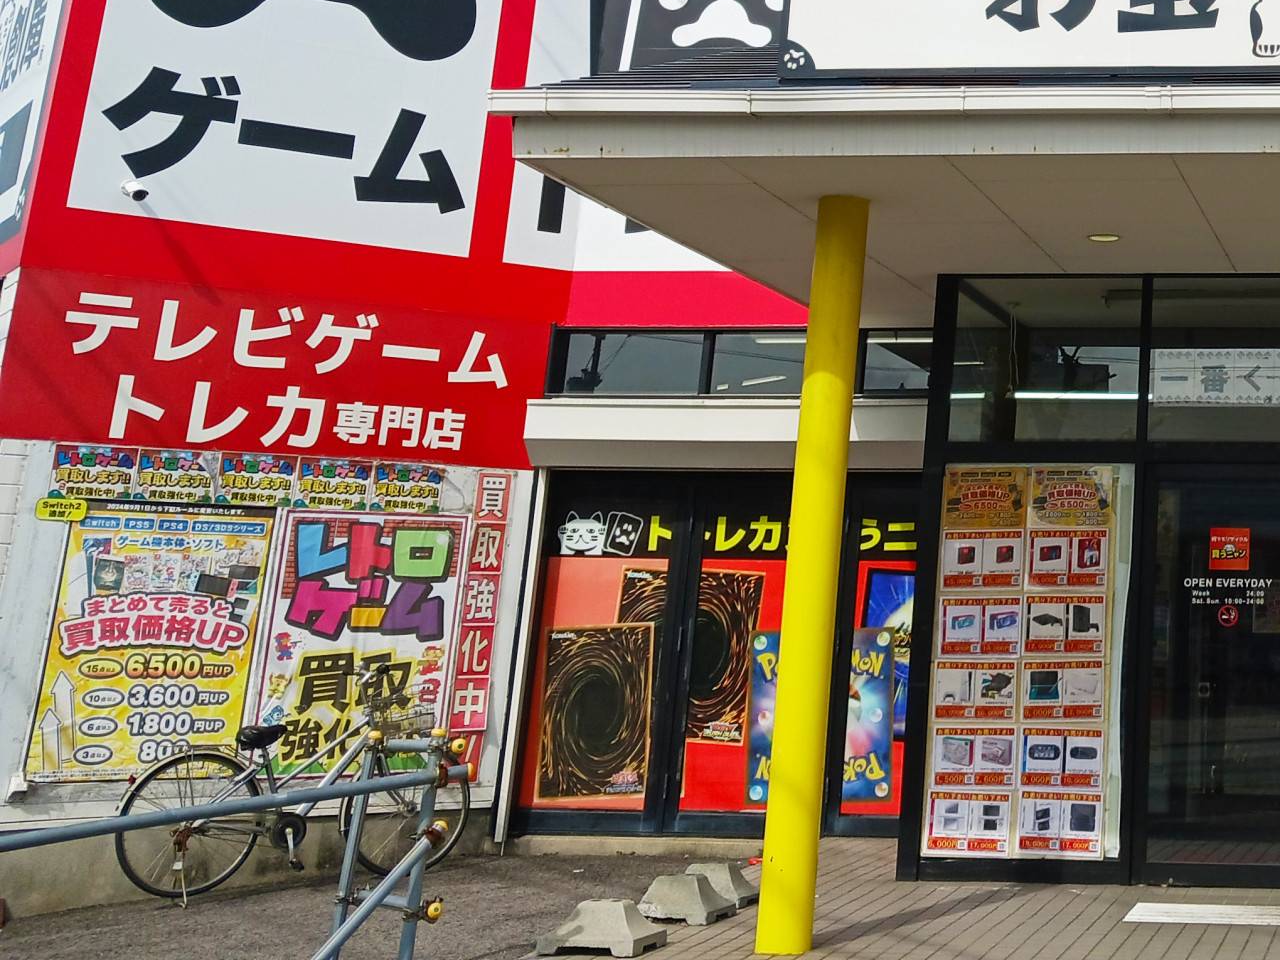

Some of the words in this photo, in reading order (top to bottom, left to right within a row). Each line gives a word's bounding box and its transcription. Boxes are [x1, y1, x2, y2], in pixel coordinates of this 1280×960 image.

[102, 66, 466, 215] ゲーム
[64, 290, 509, 390] テレビゲーム
[108, 374, 466, 451] トレカ専門店
[56, 451, 134, 469] レトロゲーム
[140, 455, 206, 472] レトロゲー
[222, 458, 293, 476] レトロゲーム
[301, 462, 369, 481] レトロゲーム
[376, 466, 443, 485] レトロゲーム
[128, 520, 150, 529] PS5
[162, 521, 184, 530] PS4
[295, 520, 456, 583] レトロ
[1183, 578, 1213, 588] OPEN
[1216, 578, 1273, 588] EVERYDAY
[86, 596, 233, 620] まとめて売ると
[284, 577, 447, 642] ゲーム
[63, 614, 247, 652] 買取価格UP
